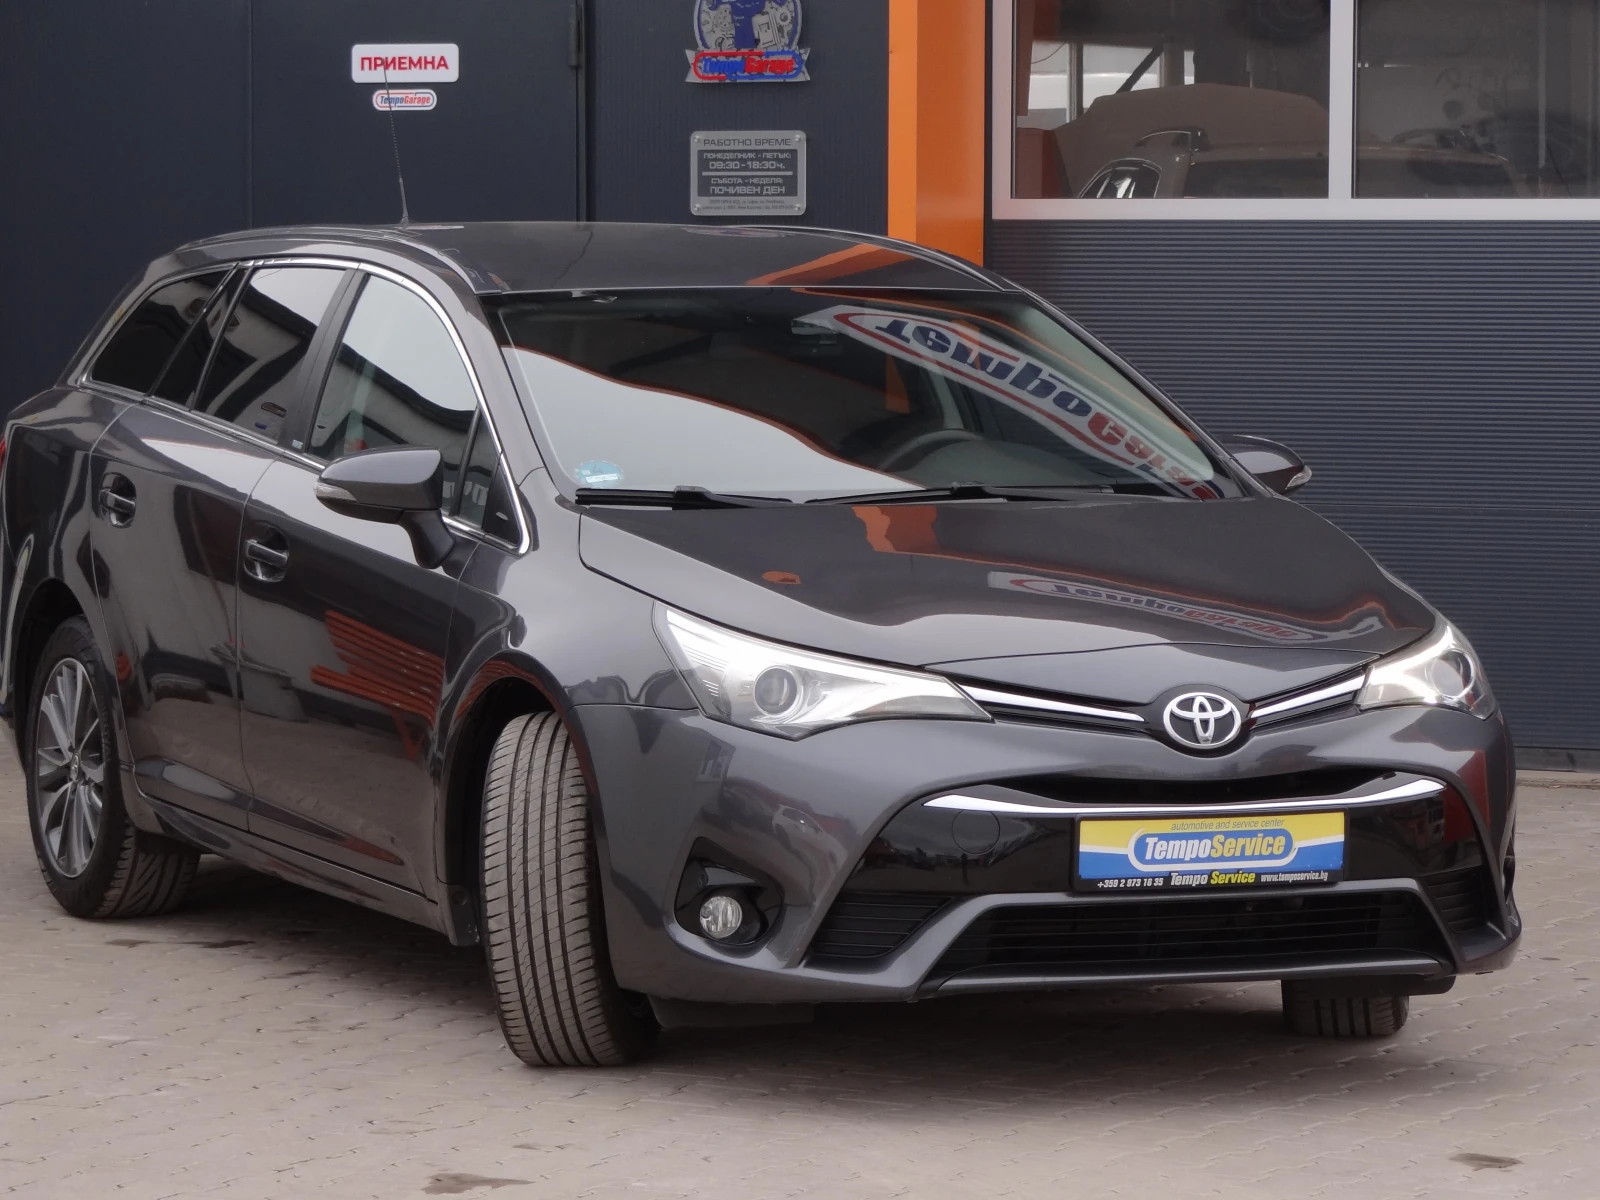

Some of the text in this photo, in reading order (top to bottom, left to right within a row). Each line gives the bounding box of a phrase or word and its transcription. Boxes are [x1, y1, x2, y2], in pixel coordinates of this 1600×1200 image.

[360, 56, 449, 71] ПРИЕМНА
[380, 95, 431, 105] TempoGarage
[703, 138, 792, 147] РАБОТНО ВРЕМЕ
[710, 186, 785, 196] ПОЧИВЕН ДЕН
[1171, 819, 1284, 831] automotive and service center
[1145, 833, 1286, 861] TempoService
[1097, 877, 1164, 888] +359 2 973 16 35
[1170, 870, 1256, 886] Tempo Service
[1260, 870, 1329, 883] www.temposervice.bg
